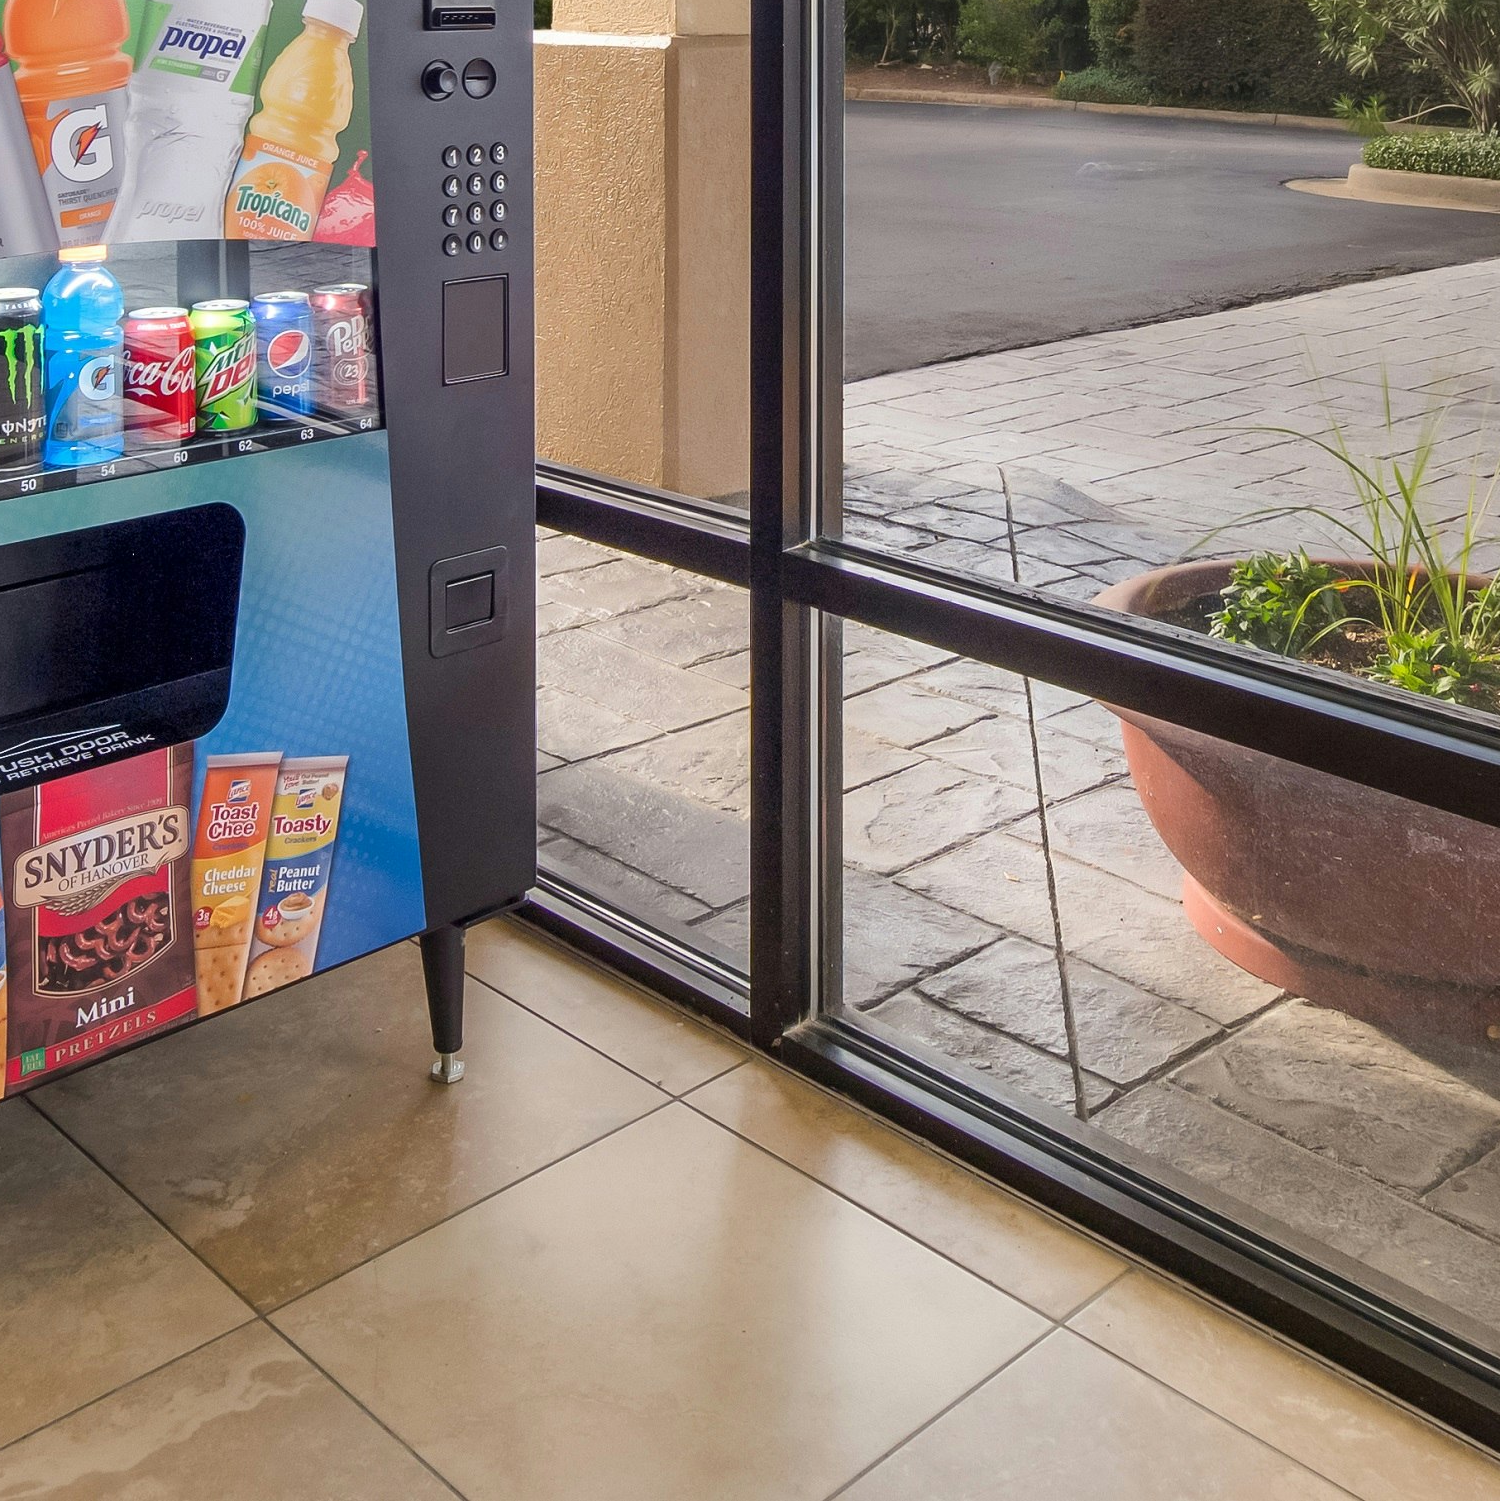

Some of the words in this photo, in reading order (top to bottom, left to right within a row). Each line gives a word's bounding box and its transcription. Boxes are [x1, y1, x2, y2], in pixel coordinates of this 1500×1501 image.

[158, 26, 247, 60] propel
[51, 102, 115, 183] G
[262, 141, 296, 161] ORANGE
[295, 151, 320, 169] JUICE
[450, 149, 457, 165] 1
[473, 148, 482, 163] 2
[496, 145, 505, 160] 3
[448, 178, 458, 194] 4
[473, 176, 481, 191] 5
[496, 174, 505, 190] 6
[134, 201, 207, 224] propel
[234, 184, 312, 233] Tropicana
[450, 208, 458, 224] 7
[473, 206, 481, 221] 8
[496, 203, 505, 218] 9
[238, 216, 267, 235] 100%
[266, 225, 299, 242] JUICE
[474, 235, 481, 250] 0
[79, 355, 115, 401] G
[344, 364, 359, 379] 23
[272, 381, 311, 398] pepsi
[360, 417, 373, 430] 64
[300, 428, 314, 441] 63
[238, 439, 253, 452] 62
[173, 450, 189, 463] 60
[100, 464, 116, 477] 54
[20, 478, 37, 492] 50
[59, 730, 131, 756] DOOR
[5, 750, 95, 781] RETRIEVE
[96, 733, 157, 755] DRINK
[210, 803, 260, 823] Toast
[207, 820, 256, 841] Chee
[273, 813, 333, 836] Toasty
[23, 813, 183, 889] SNYDER'S
[58, 875, 77, 892] OF
[79, 853, 150, 887] HANOVER
[204, 865, 257, 883] Cheddar
[278, 864, 321, 879] Peanut
[202, 881, 247, 897] Cheese
[276, 878, 315, 893] Butter
[197, 908, 210, 922] 3g
[266, 907, 279, 921] 4g
[75, 986, 136, 1029] Mini
[55, 1010, 157, 1063] PRETZELS
